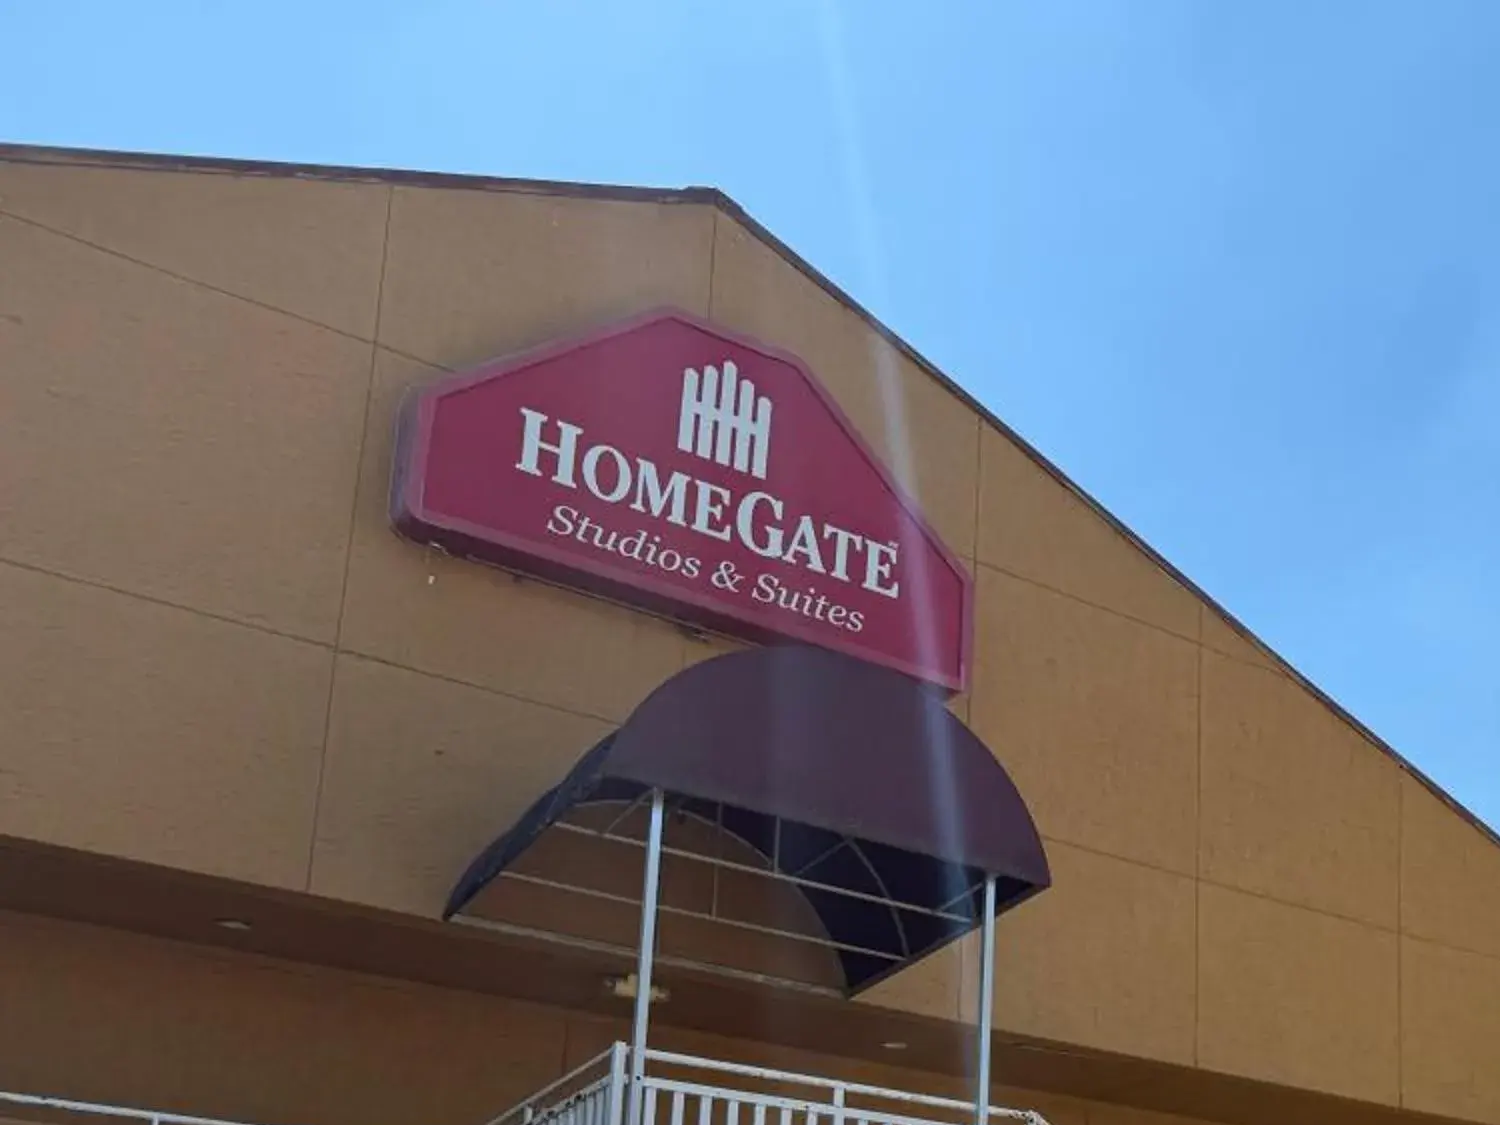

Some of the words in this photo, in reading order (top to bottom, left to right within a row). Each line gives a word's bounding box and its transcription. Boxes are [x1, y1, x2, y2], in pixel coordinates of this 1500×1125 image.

[514, 407, 900, 599] HOMEGATE
[546, 505, 702, 579] Studios
[711, 562, 744, 593] &
[751, 572, 865, 633] Suites
